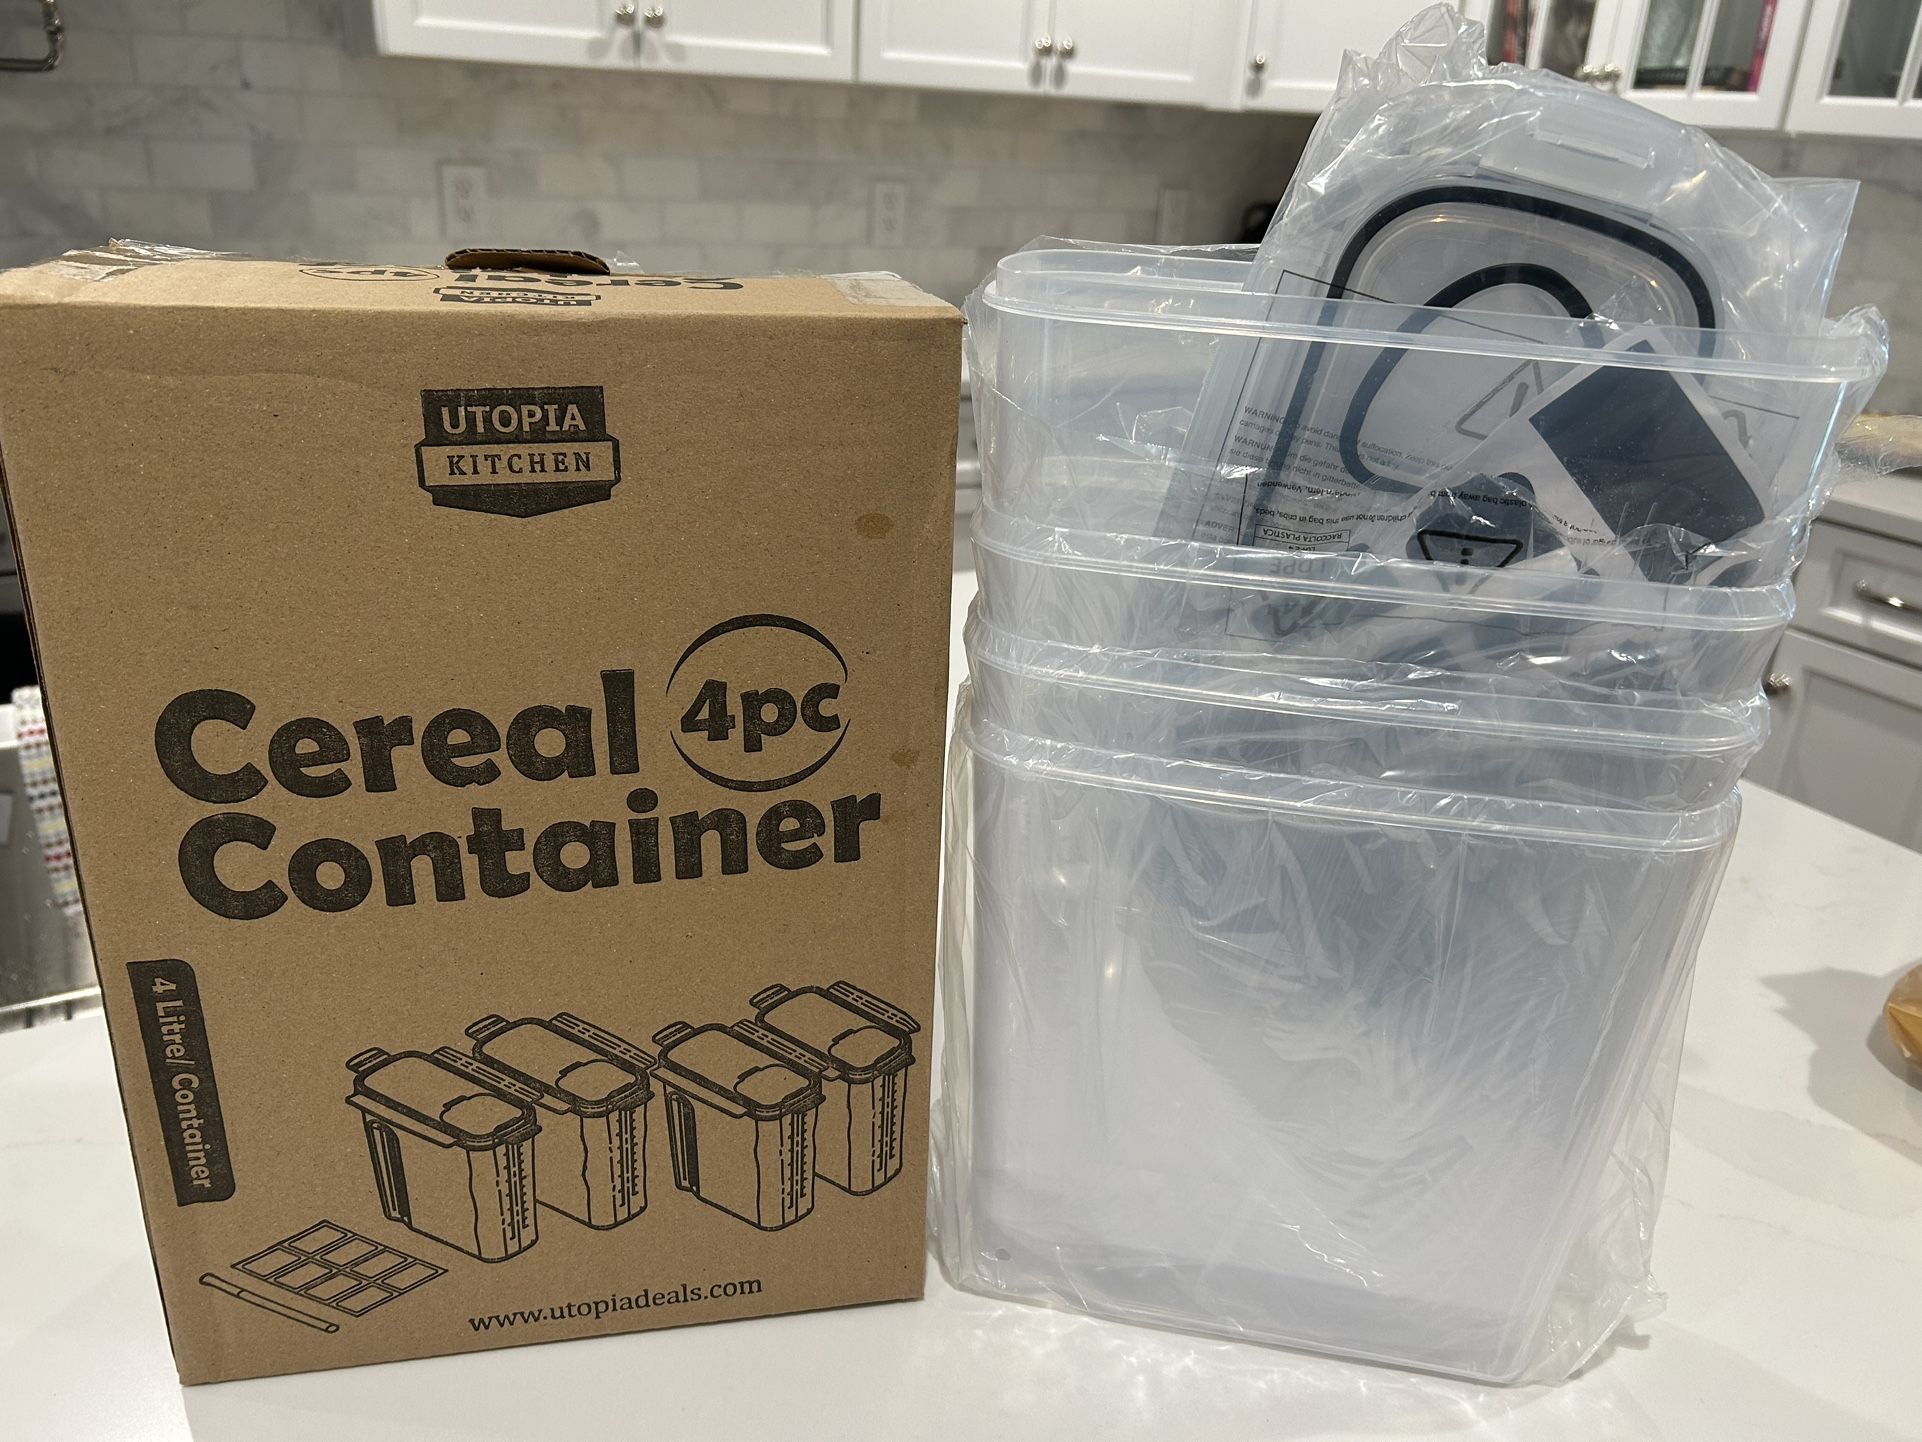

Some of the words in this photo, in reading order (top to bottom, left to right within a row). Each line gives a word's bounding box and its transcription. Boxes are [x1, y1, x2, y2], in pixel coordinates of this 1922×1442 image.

[441, 403, 587, 434] UTOPIA
[1234, 435, 1274, 452] WARNUN
[447, 451, 591, 476] KITCHEN
[1457, 490, 1482, 502] away
[1482, 494, 1500, 505] bag
[1307, 515, 1324, 526] bag
[1262, 527, 1301, 542] PLASTICA
[1303, 531, 1343, 543] RACCOLTA
[154, 669, 642, 804] Cereal
[680, 679, 842, 752] 4pc
[178, 788, 882, 920] Container
[152, 977, 177, 994] 4
[155, 1000, 196, 1064] Litre/
[171, 1072, 213, 1188] Container
[468, 1278, 763, 1332] www.utopiadeals.com
